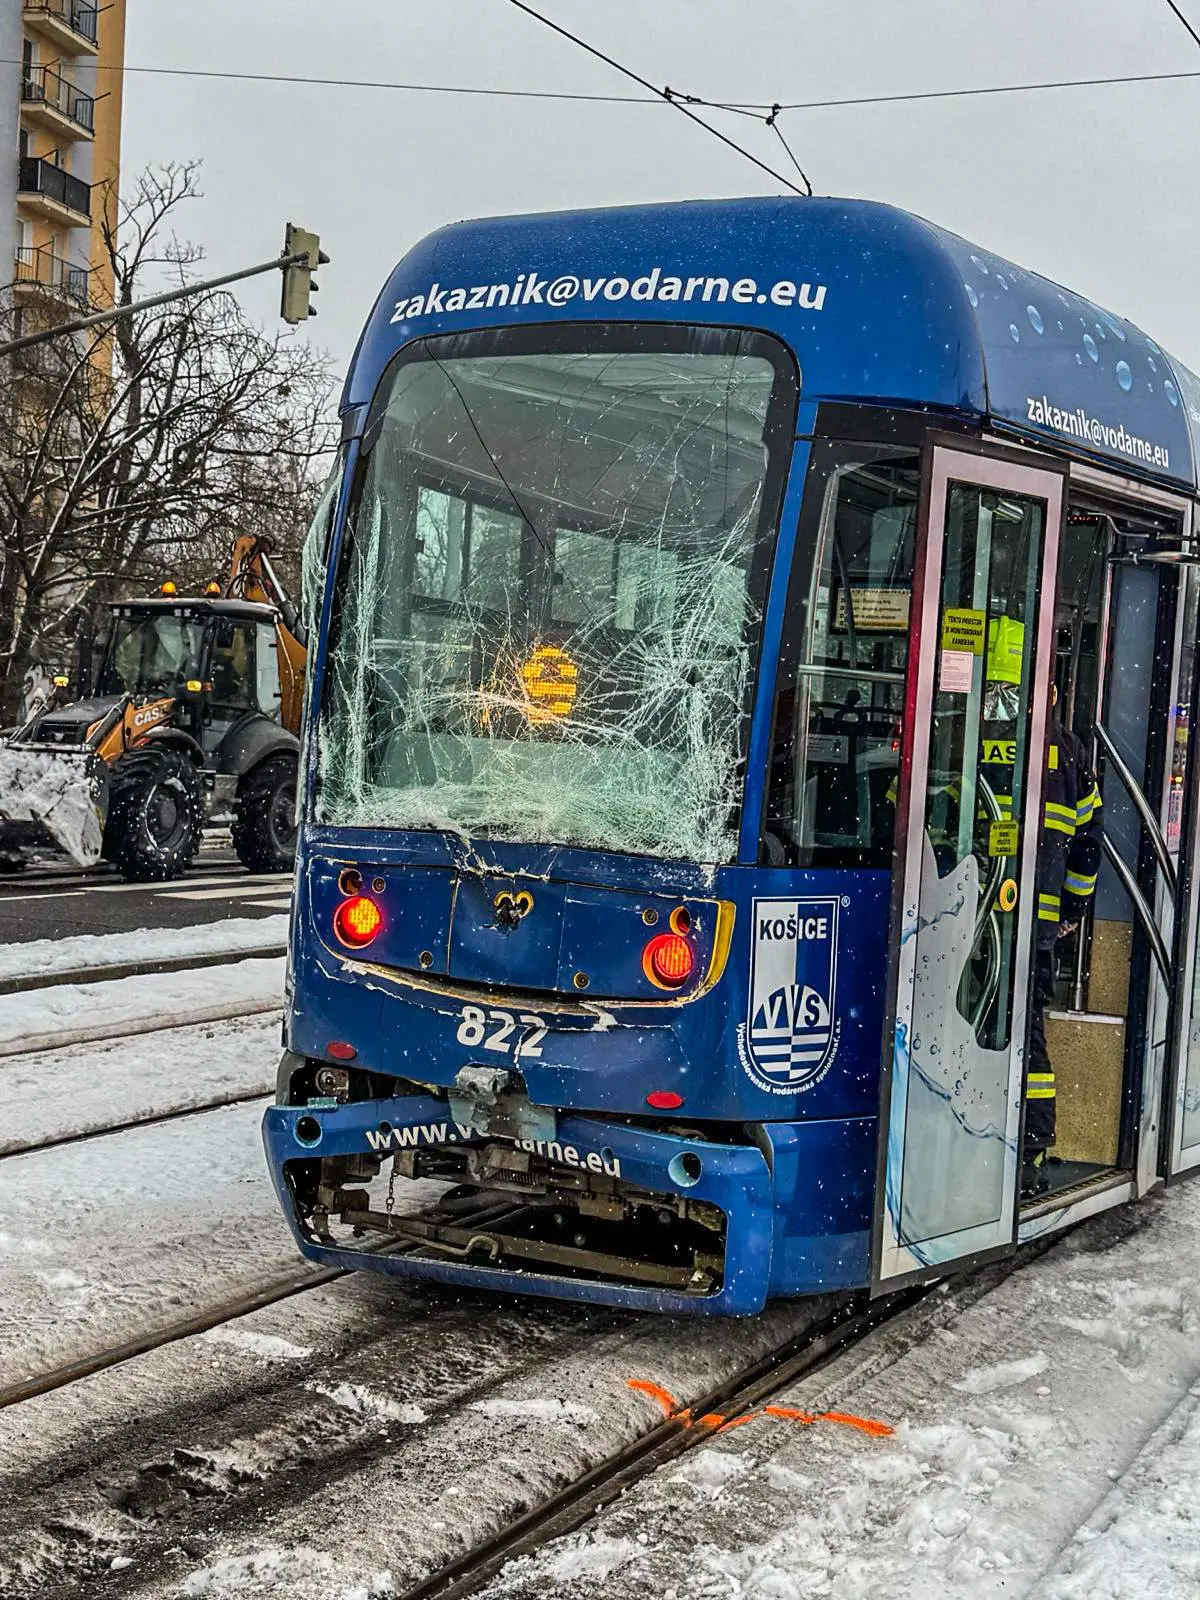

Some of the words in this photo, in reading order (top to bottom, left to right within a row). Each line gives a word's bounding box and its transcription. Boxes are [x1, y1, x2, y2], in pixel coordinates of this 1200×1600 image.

[389, 267, 827, 324] zakaznik@vodarne.eu
[1026, 395, 1169, 468] zakaznik@vodarne.eu
[759, 914, 828, 940] KOŠICE
[456, 1005, 549, 1057] 822
[365, 1123, 621, 1178] www.varne.eu
